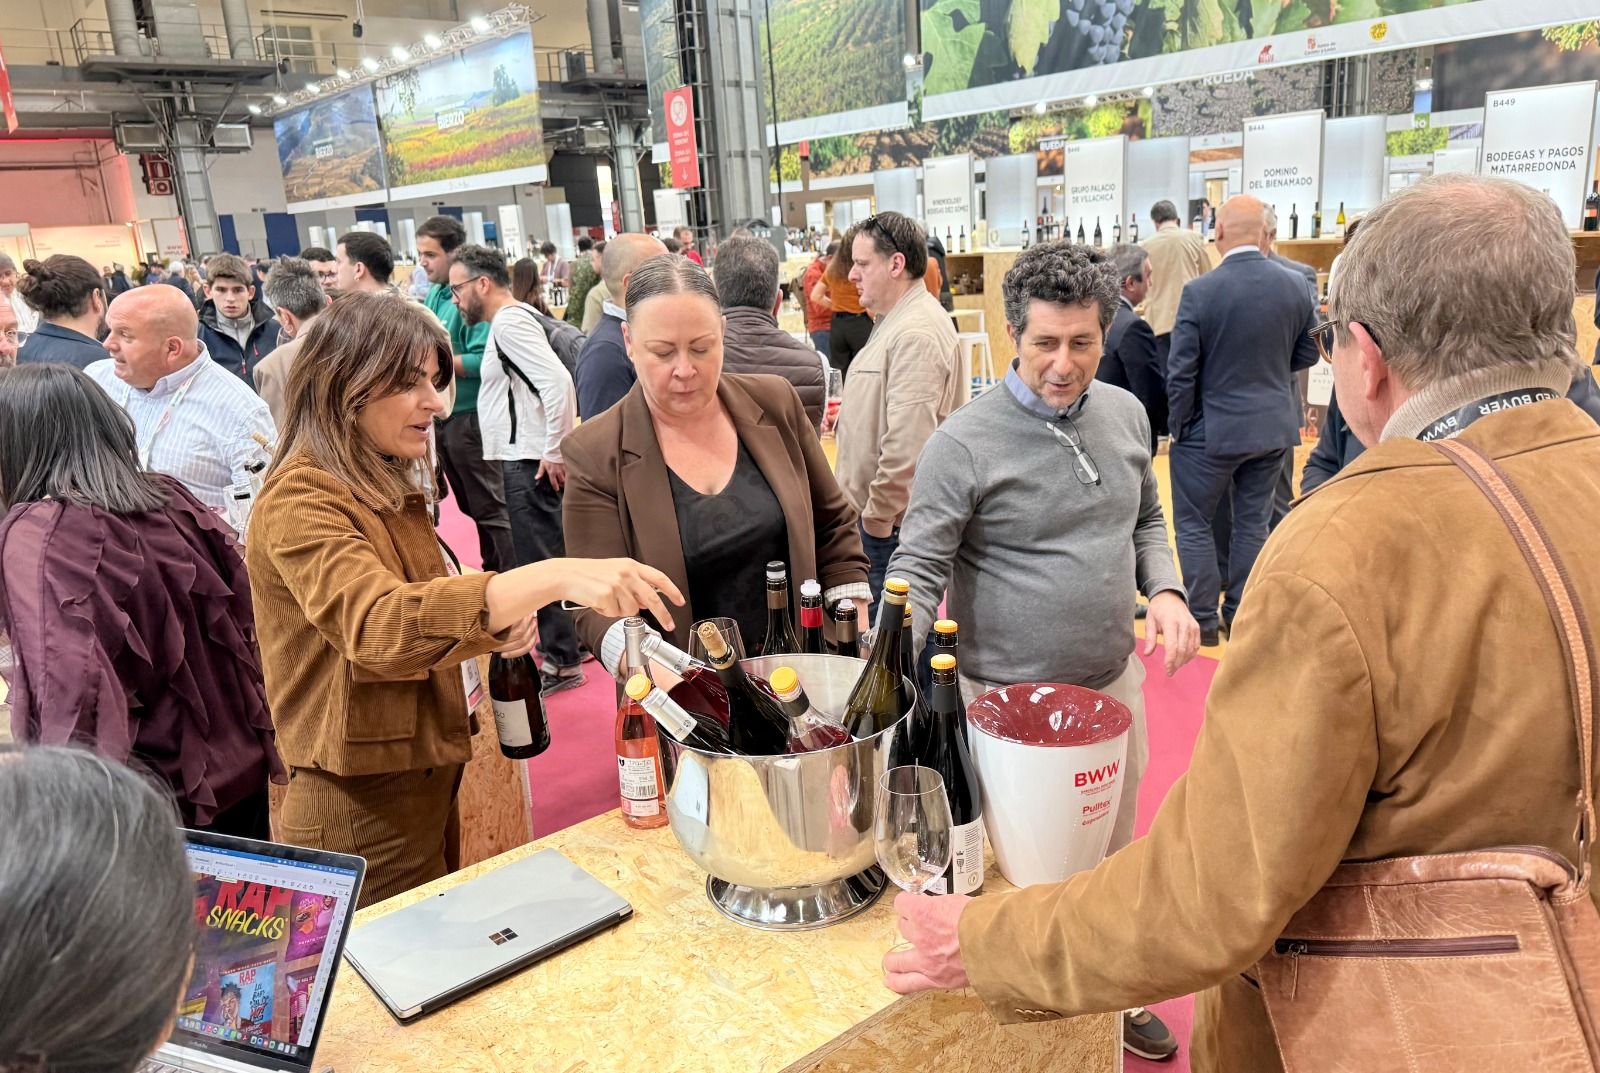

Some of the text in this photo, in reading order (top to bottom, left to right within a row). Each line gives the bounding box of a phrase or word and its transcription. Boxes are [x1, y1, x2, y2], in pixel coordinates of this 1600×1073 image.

[1493, 98, 1516, 107] B449
[1486, 146, 1584, 162] BODEGAS Y PAGOS
[1264, 166, 1298, 177] DOMINIO
[1490, 160, 1577, 175] MATARREDONDA
[1071, 183, 1116, 195] GRUPO PALACIO
[1249, 176, 1313, 190] DEL BIENAMADO
[1072, 193, 1114, 204] DE VILLACHICA
[1479, 393, 1532, 415] BUYER
[1422, 416, 1458, 442] BWW
[1074, 758, 1120, 788] BWW
[1083, 800, 1111, 814] Pulltex
[215, 879, 294, 918] RAP
[206, 905, 285, 940] SNACKS
[239, 969, 256, 984] RAP
